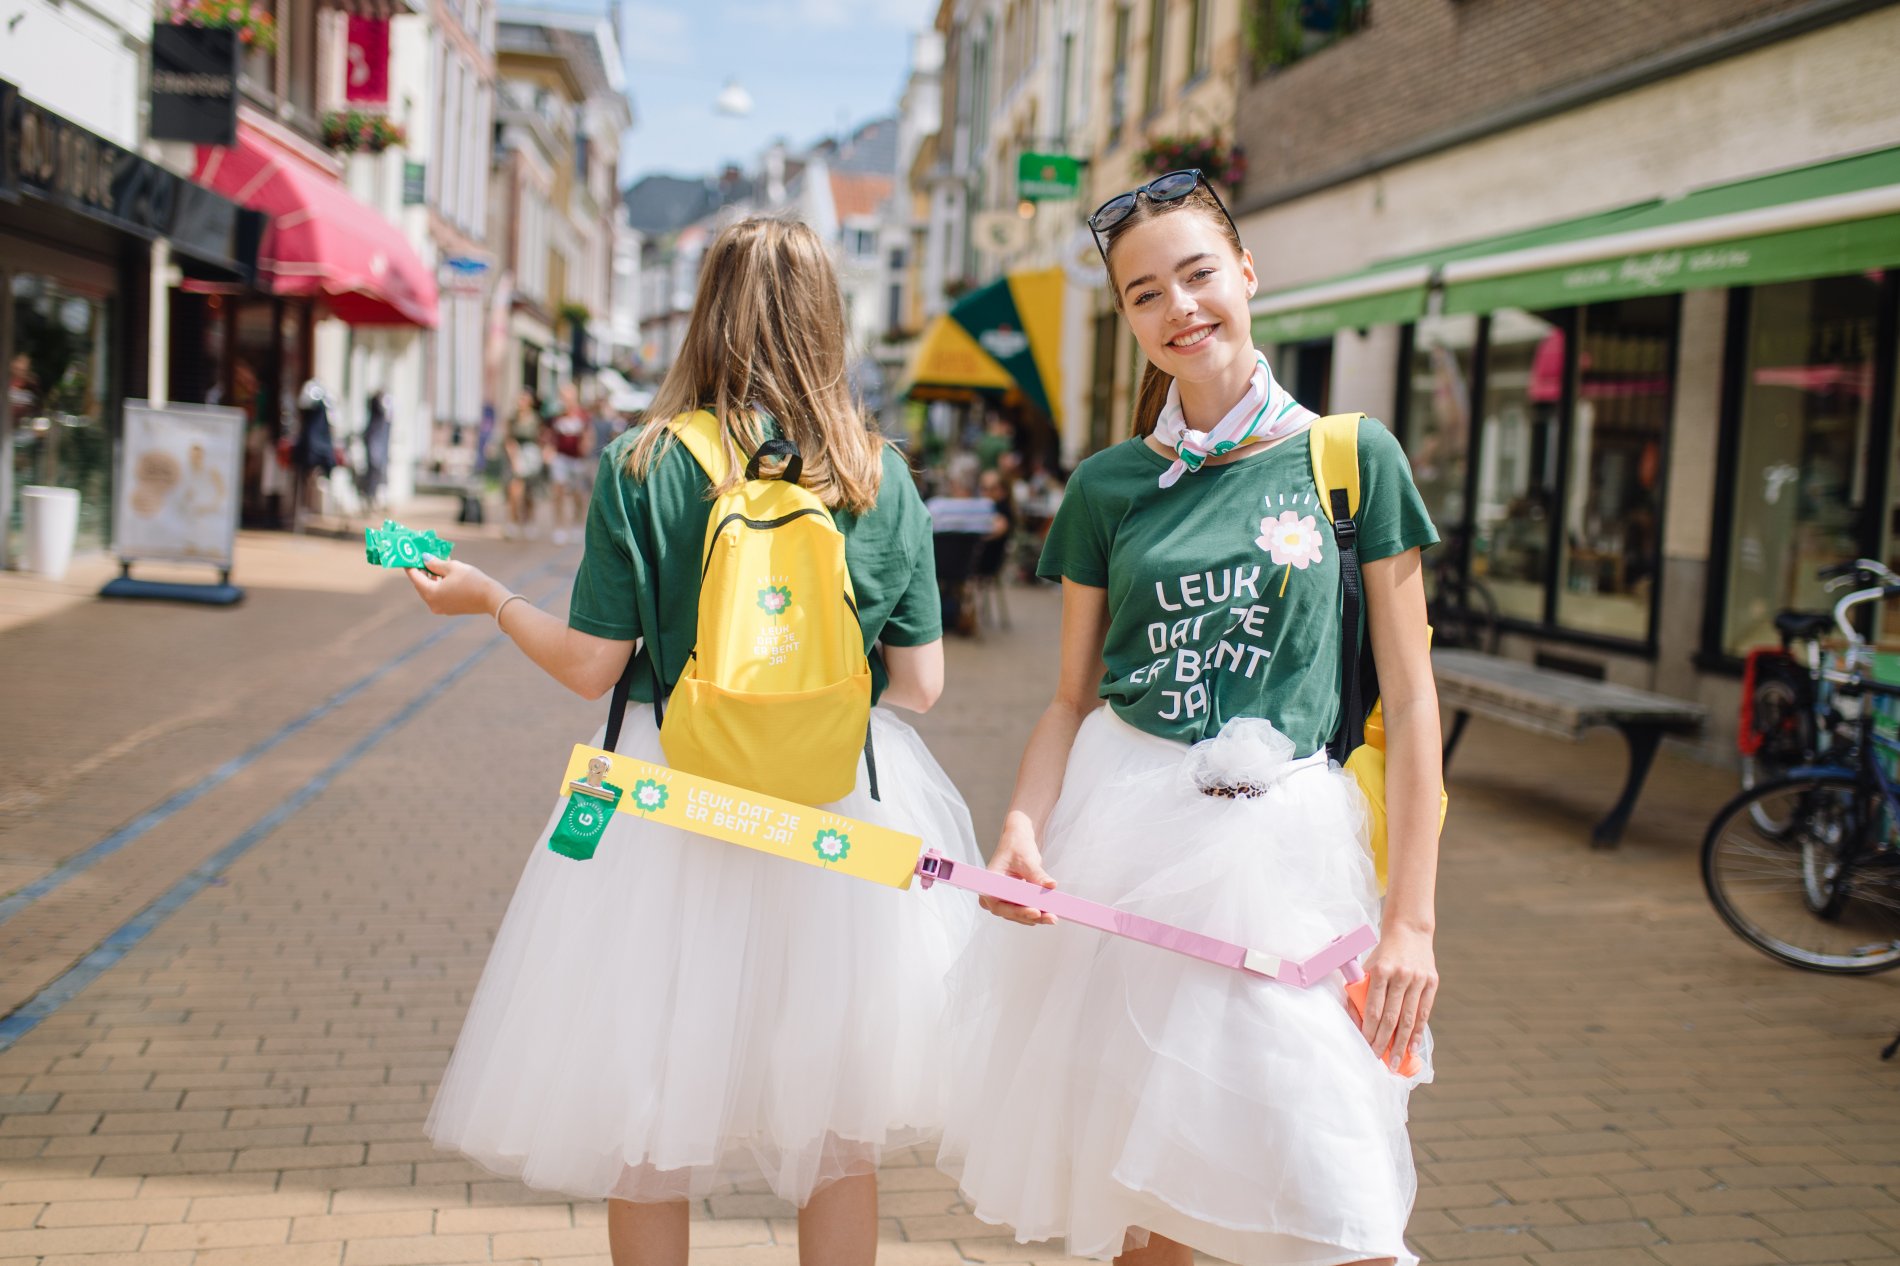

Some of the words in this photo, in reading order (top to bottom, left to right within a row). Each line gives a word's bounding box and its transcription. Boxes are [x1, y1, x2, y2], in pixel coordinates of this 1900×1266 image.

[1155, 565, 1261, 612] LEUK
[757, 636, 778, 645] DAT
[784, 633, 795, 643] JE
[762, 624, 788, 635] LEUK
[1147, 612, 1213, 655] DAT
[1222, 604, 1270, 638] JE
[754, 646, 768, 655] ER
[772, 642, 799, 654] BENT
[769, 655, 786, 665] JA!
[1129, 658, 1171, 684] ER
[687, 787, 735, 812] LEUK
[737, 801, 775, 823] DAT
[777, 812, 801, 831] JE
[685, 803, 709, 823] ER
[712, 811, 761, 836] BENT
[762, 825, 795, 846] JA!
